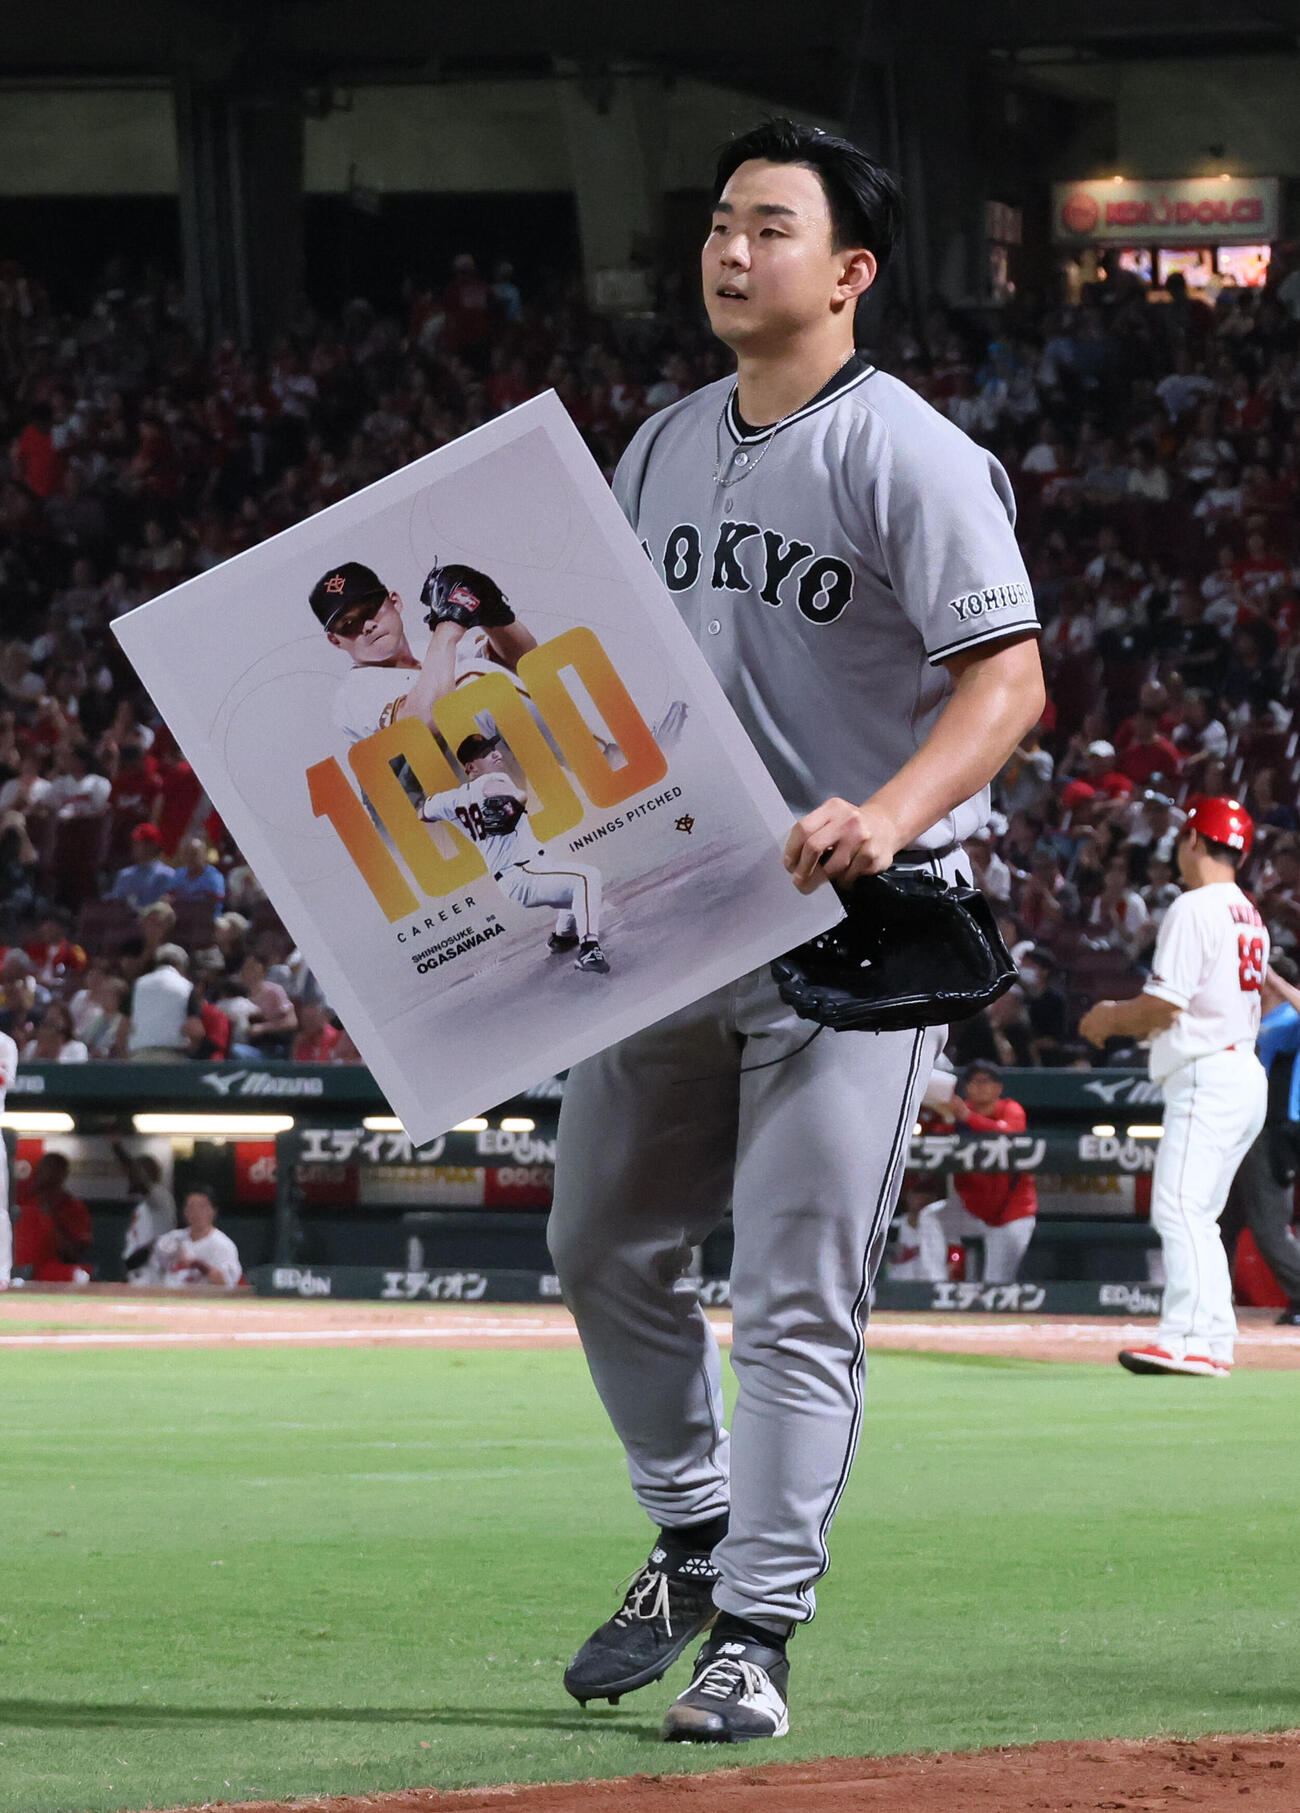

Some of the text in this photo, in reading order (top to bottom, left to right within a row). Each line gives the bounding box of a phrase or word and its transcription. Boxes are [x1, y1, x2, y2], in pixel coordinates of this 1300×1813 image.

[641, 520, 855, 625] OKYO
[306, 626, 668, 924] 1000
[569, 786, 682, 852] INNINGS PITCHED
[397, 896, 476, 943] CAREER
[411, 926, 475, 963] SHINNOSUKE
[416, 923, 506, 974] OGASAWARA
[931, 1282, 1046, 1311] エディオン
